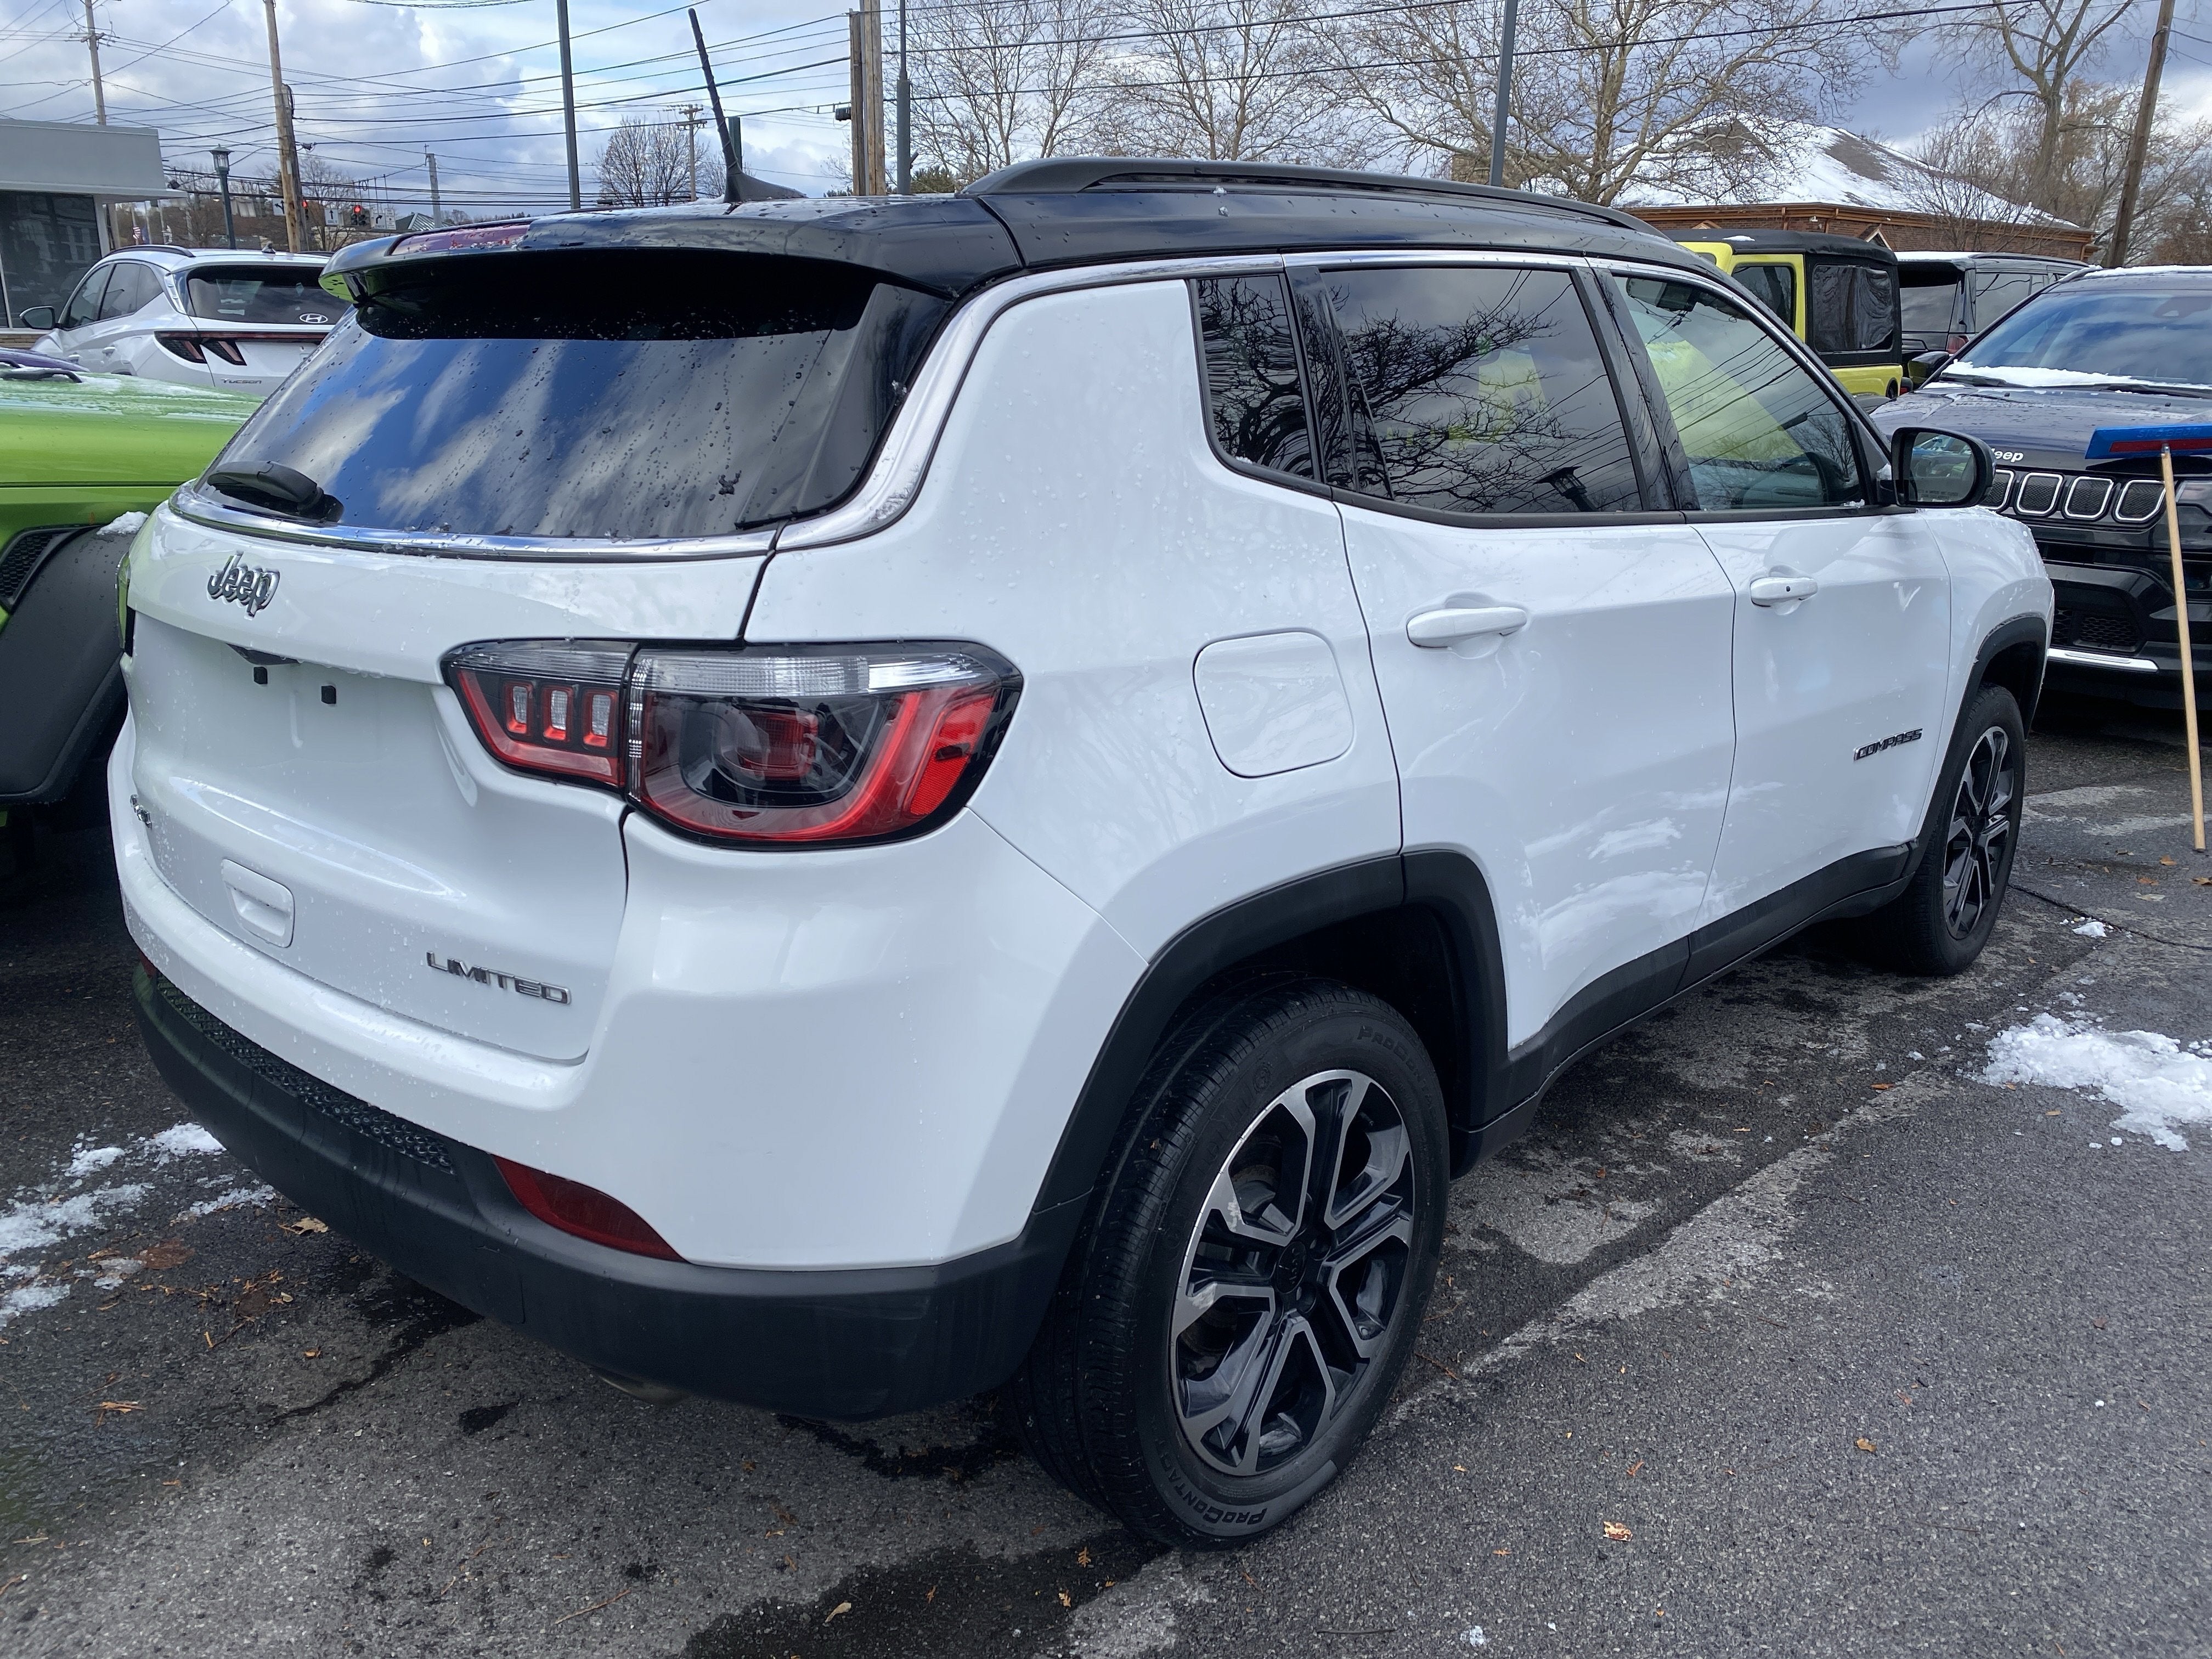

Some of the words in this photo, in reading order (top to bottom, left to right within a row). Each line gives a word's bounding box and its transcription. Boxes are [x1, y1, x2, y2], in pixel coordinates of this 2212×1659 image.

[207, 551, 280, 618] Jeep
[1853, 727, 1923, 761] COMPASS
[426, 951, 571, 1005] LIMITED
